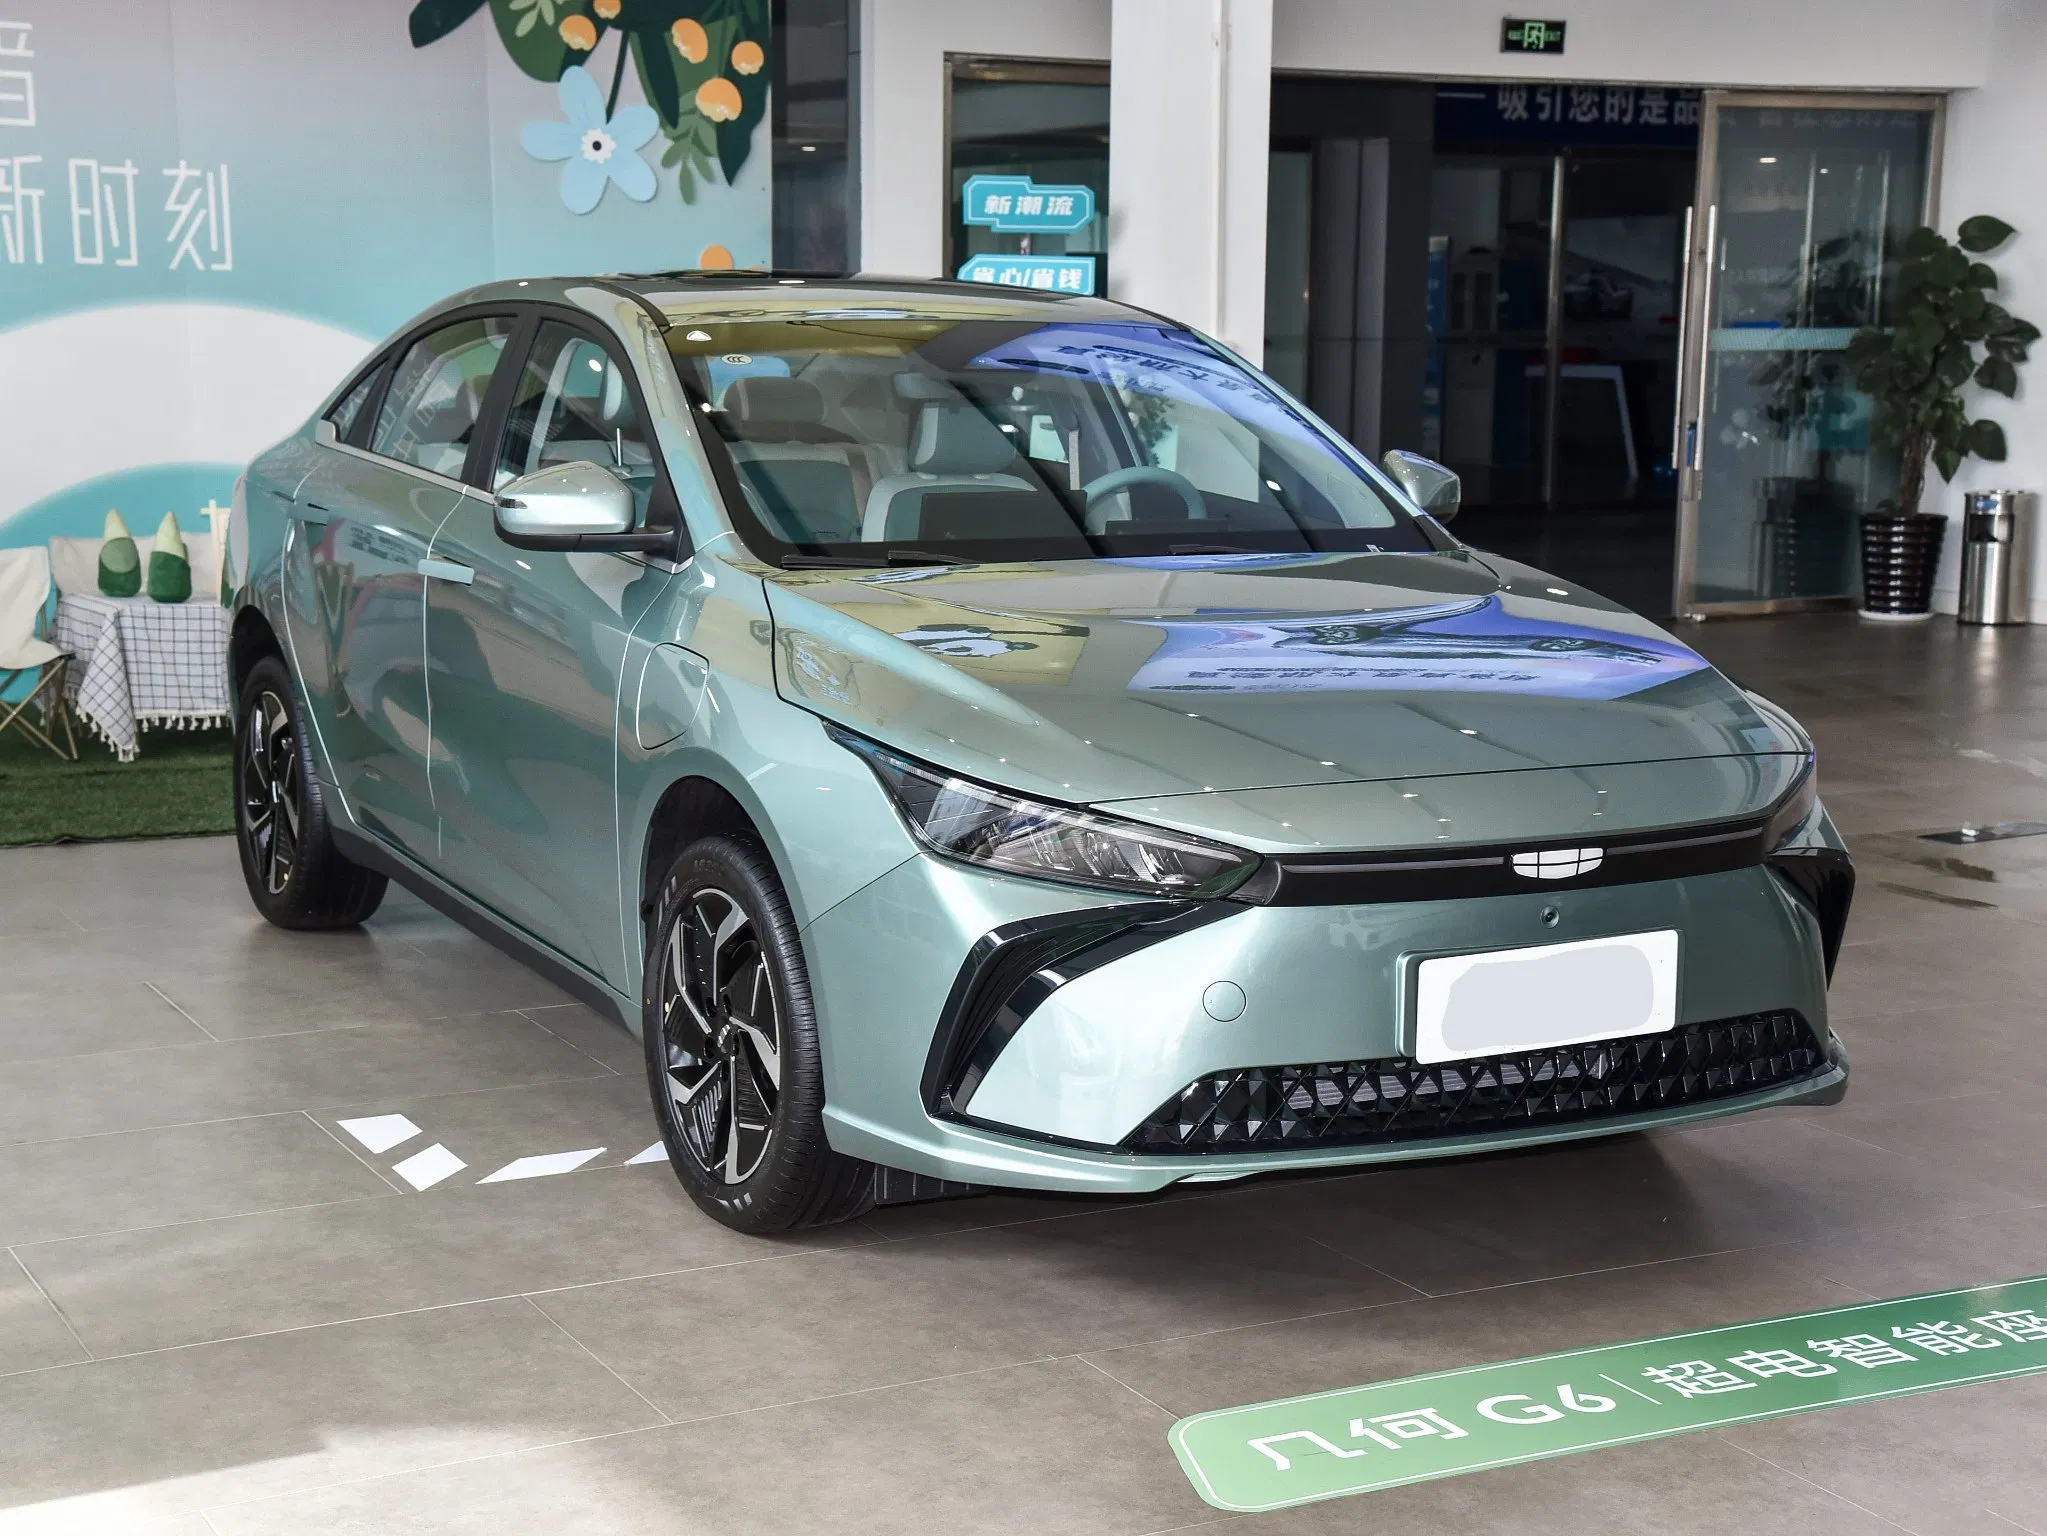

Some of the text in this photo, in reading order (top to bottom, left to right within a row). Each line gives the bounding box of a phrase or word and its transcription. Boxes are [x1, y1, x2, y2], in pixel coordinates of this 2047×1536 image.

[984, 194, 1075, 215] 新潮流
[1247, 1309, 2047, 1471] 几何 G6 超电智能座
